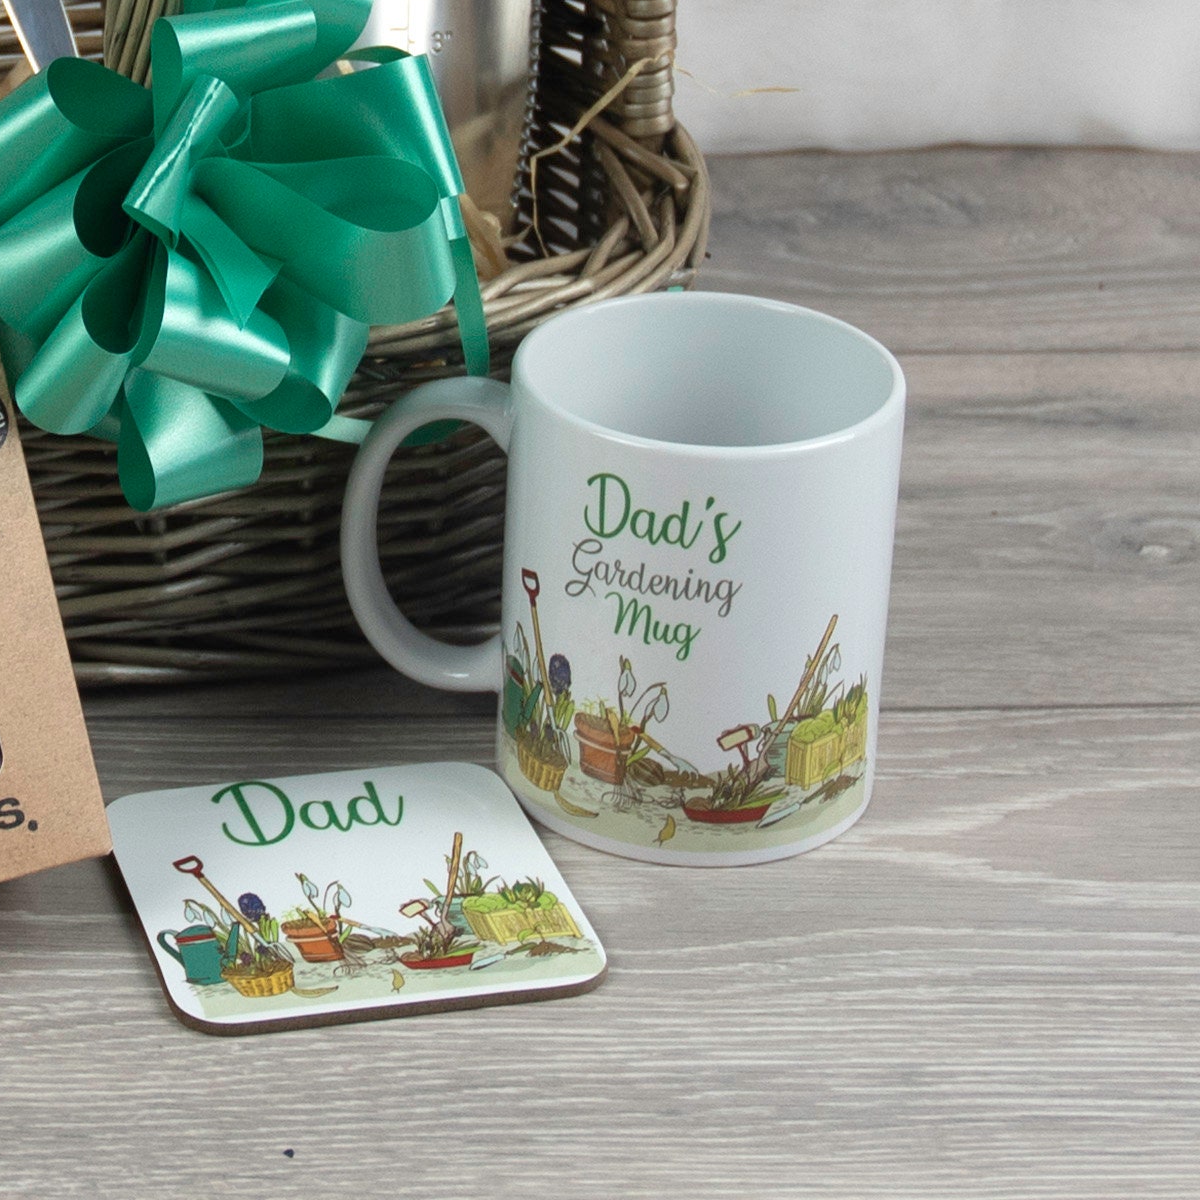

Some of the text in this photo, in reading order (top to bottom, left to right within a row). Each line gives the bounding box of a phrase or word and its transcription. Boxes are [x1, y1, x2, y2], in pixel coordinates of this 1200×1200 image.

[585, 472, 742, 564] Dad's
[564, 538, 743, 618] Gardening
[604, 591, 702, 661] Mug
[210, 780, 404, 847] Dad
